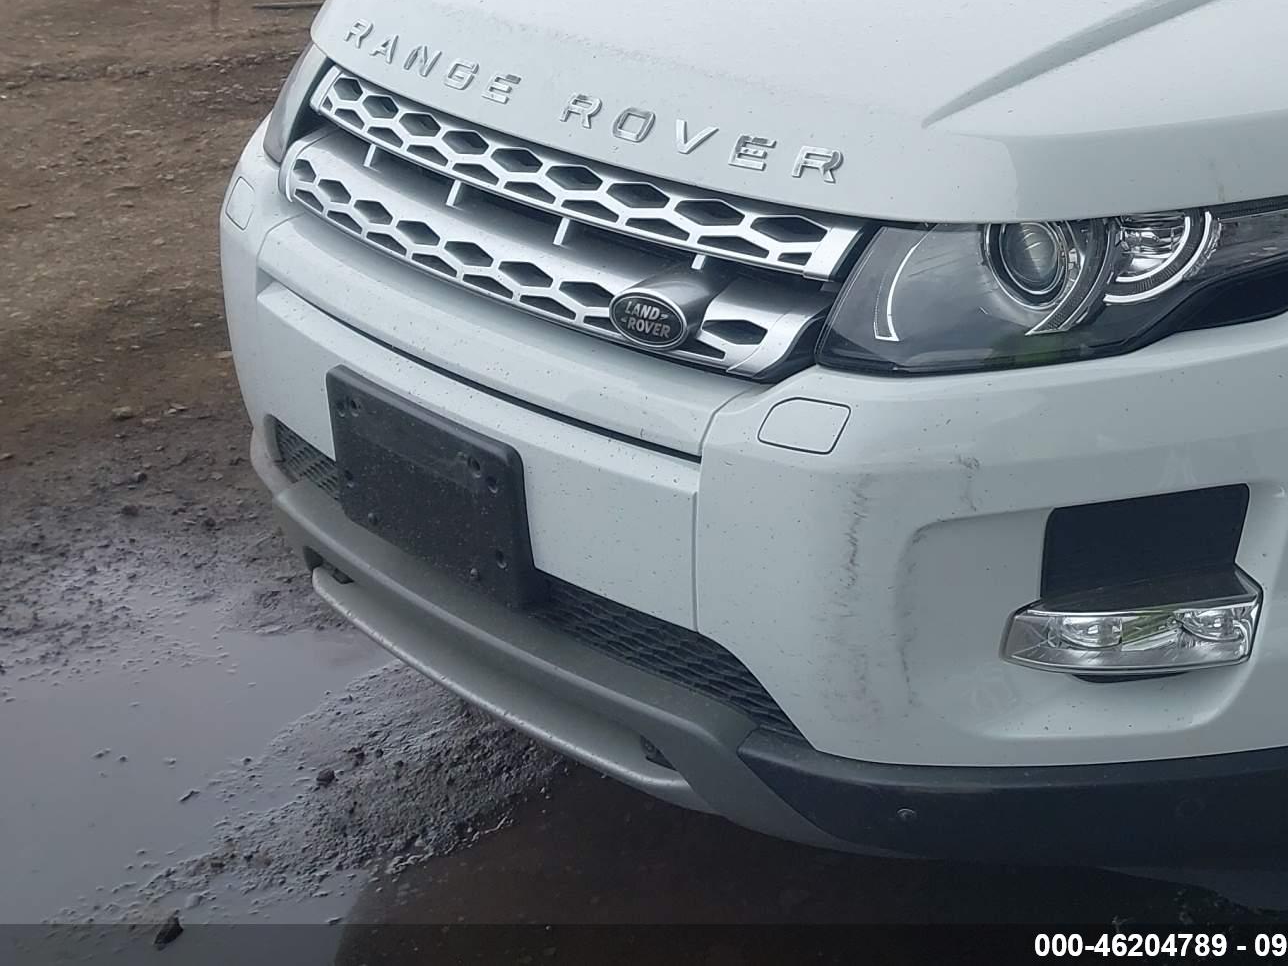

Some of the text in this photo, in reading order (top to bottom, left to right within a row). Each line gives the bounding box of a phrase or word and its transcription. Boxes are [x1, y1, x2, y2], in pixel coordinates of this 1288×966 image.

[343, 18, 845, 183] RANGE ROVER
[624, 301, 661, 321] LAND
[627, 317, 671, 339] ROVER
